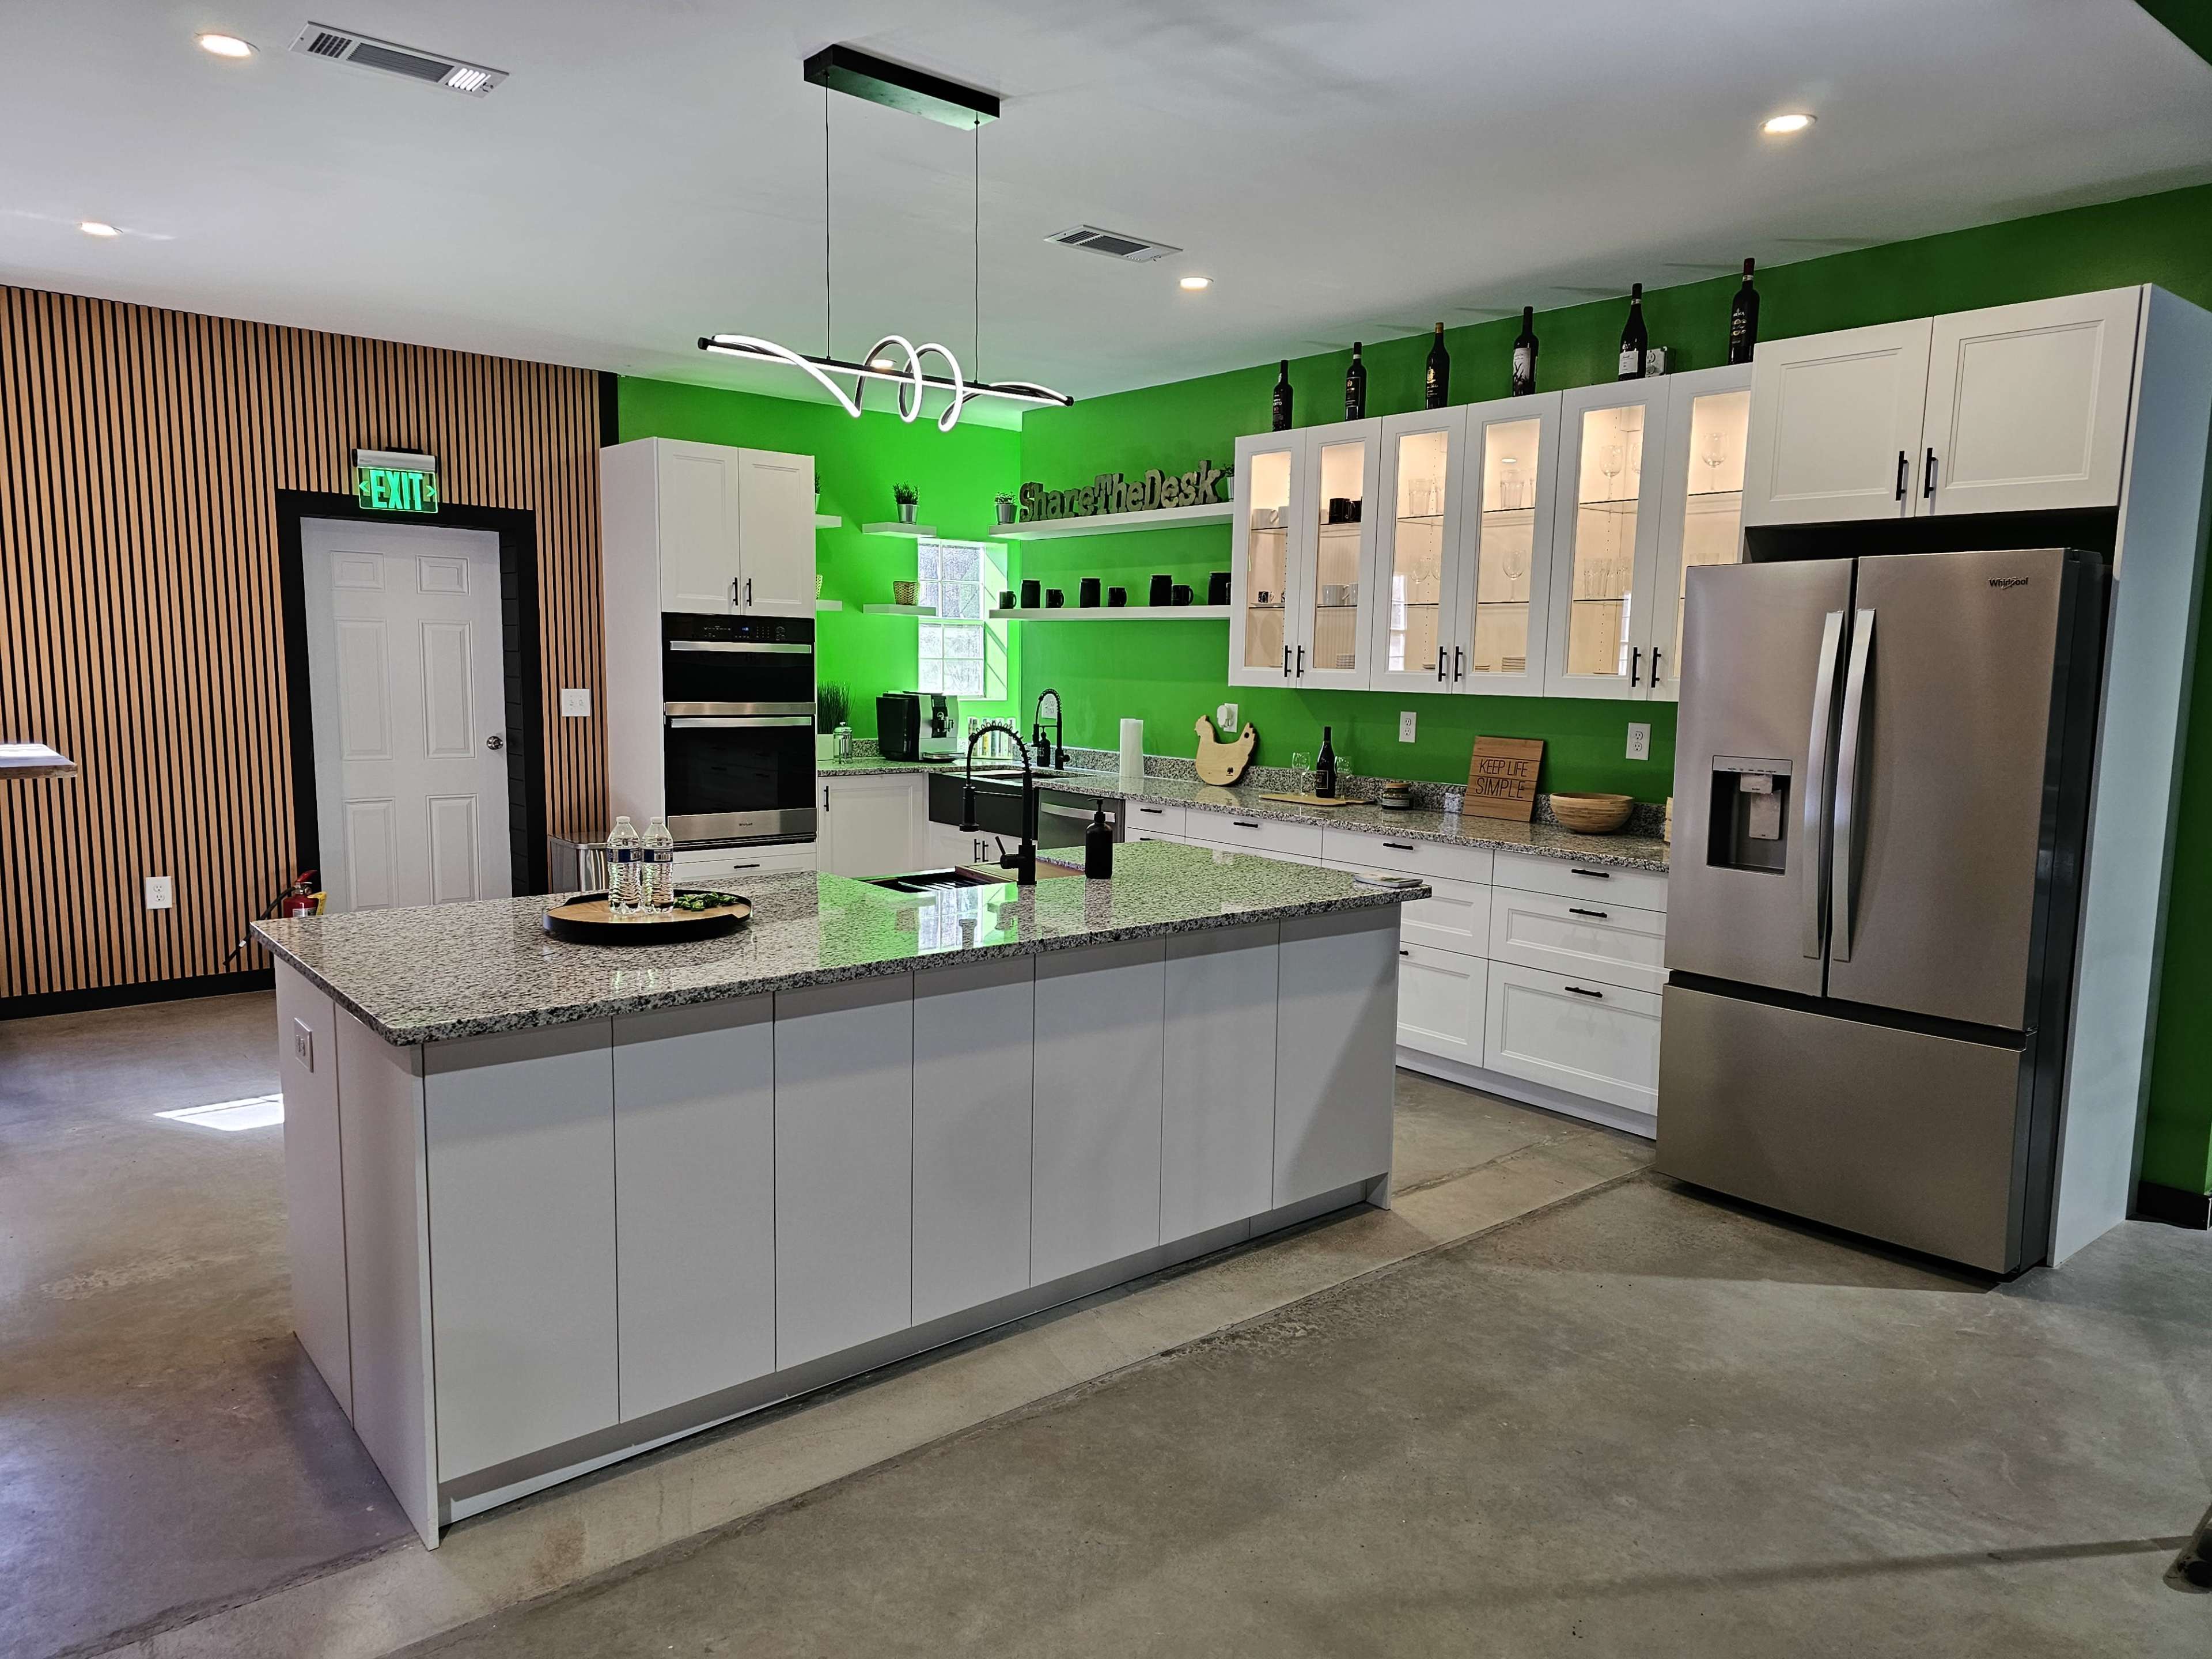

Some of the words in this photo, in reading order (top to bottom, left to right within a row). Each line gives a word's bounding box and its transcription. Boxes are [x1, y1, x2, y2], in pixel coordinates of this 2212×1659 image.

[369, 469, 423, 510] EXIT
[1019, 460, 1225, 523] ShareTheDesk
[1988, 577, 2029, 588] Whirlpool
[1479, 759, 1506, 775] KEEP
[1507, 761, 1529, 777] LIFE
[1475, 777, 1526, 799] SIMPLE
